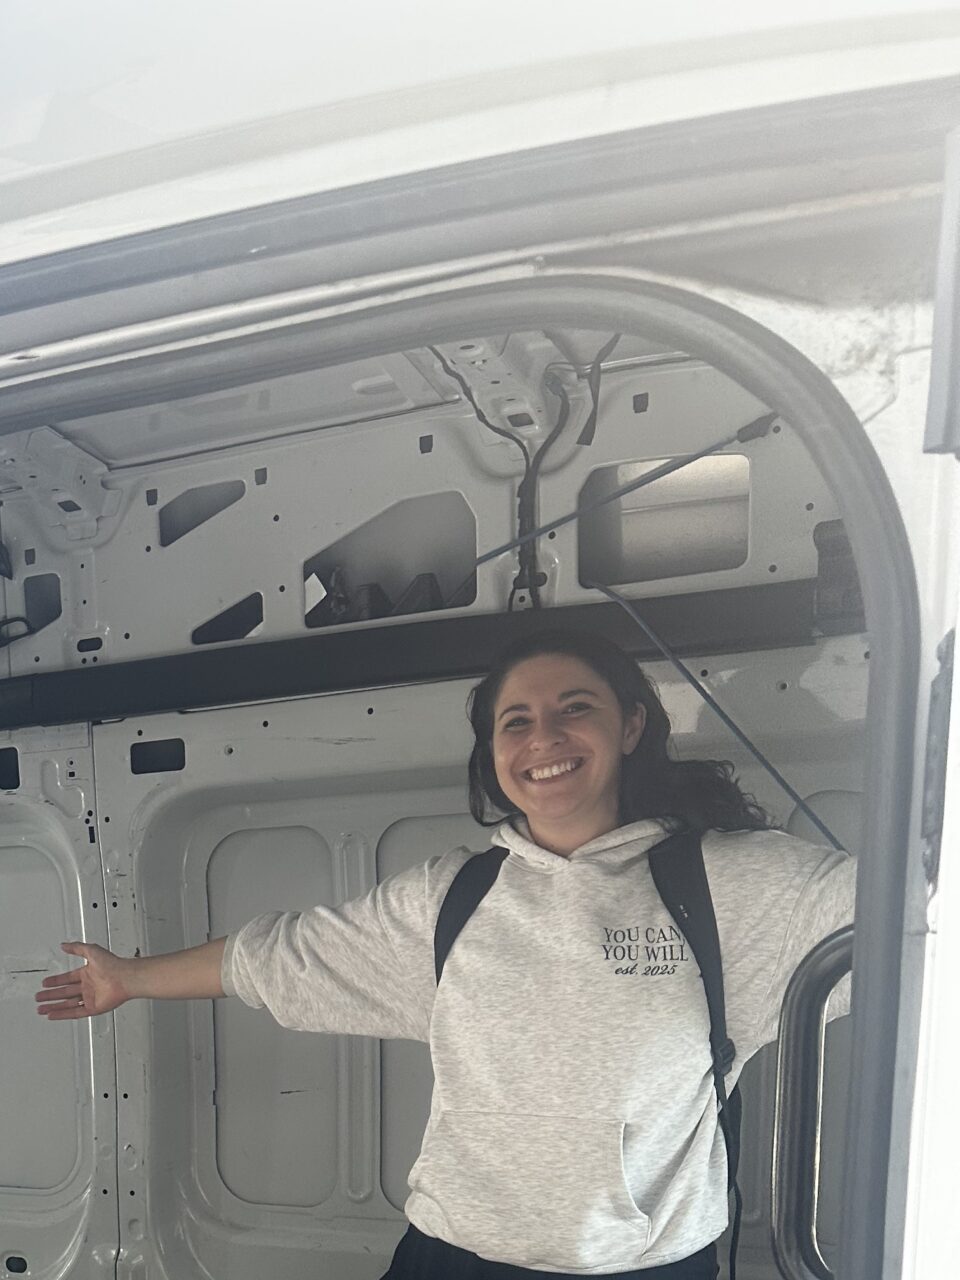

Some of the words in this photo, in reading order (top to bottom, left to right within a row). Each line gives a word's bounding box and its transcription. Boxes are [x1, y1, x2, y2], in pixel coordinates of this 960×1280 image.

[603, 926, 640, 943] YOU
[601, 944, 639, 961] YOU
[644, 944, 689, 961] WILL
[614, 963, 638, 975] est.
[642, 964, 678, 976] 2025
